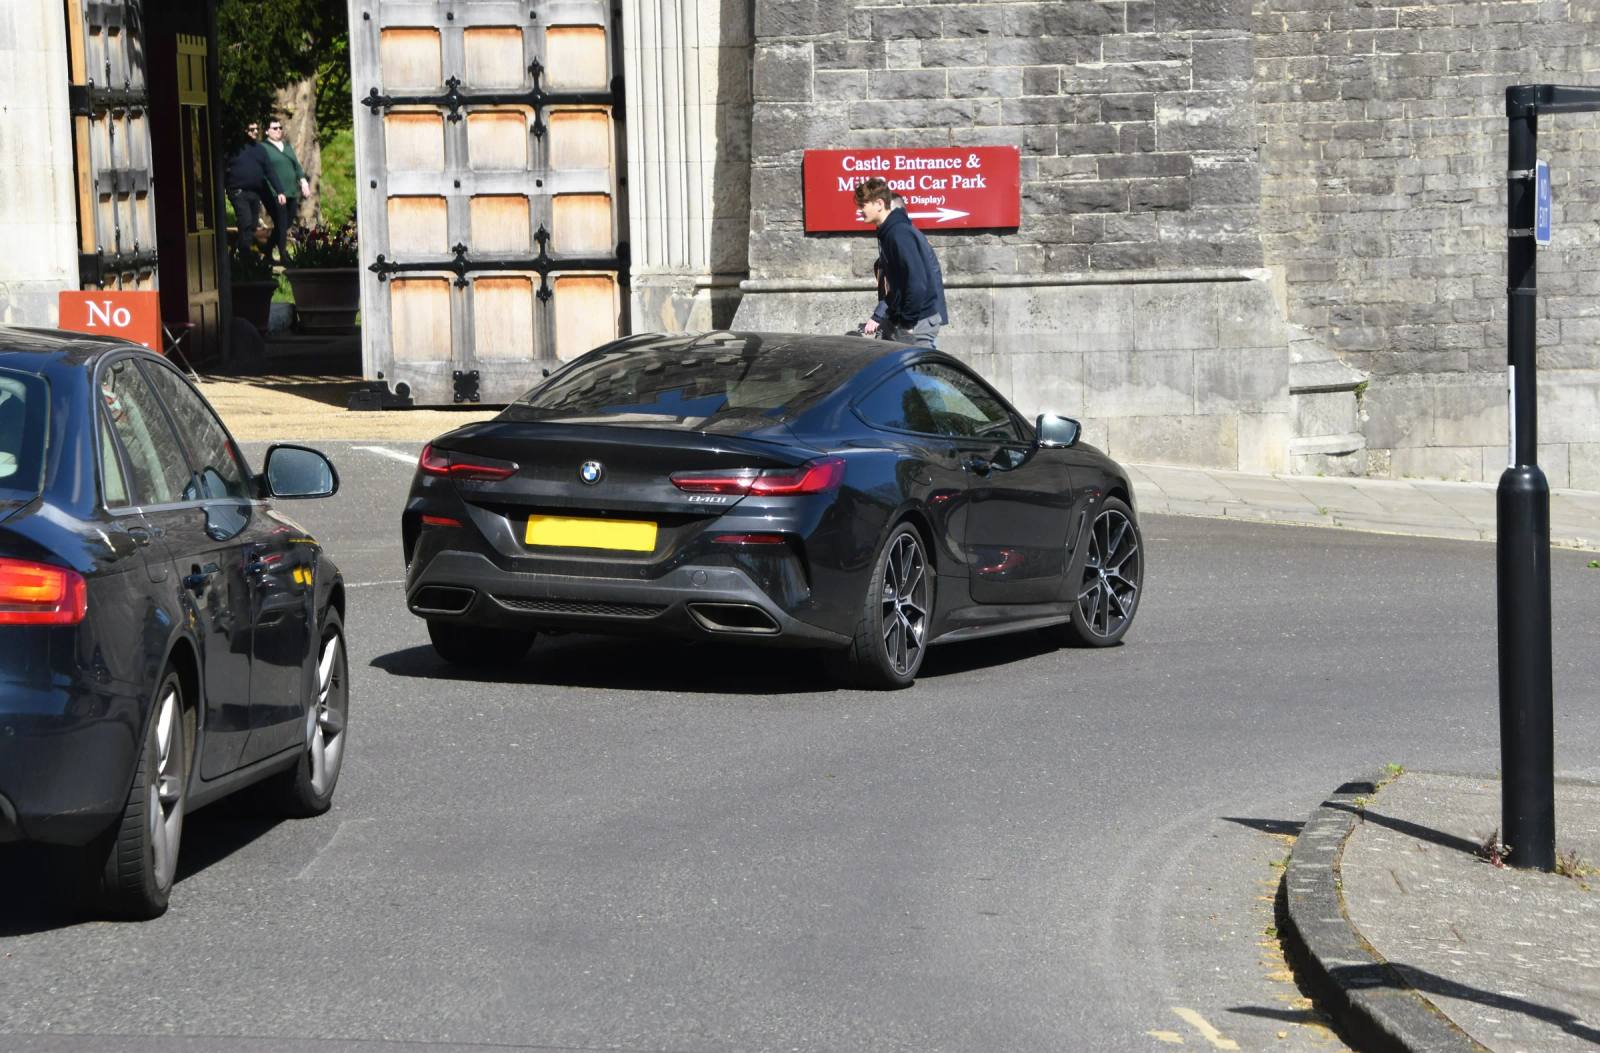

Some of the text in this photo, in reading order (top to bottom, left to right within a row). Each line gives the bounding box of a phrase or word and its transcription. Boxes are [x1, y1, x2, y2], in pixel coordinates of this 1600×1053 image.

[842, 154, 981, 171] Castle Entrance &
[919, 175, 948, 190] Car
[951, 174, 986, 189] Park
[911, 195, 946, 206] Display)
[85, 300, 132, 328] No
